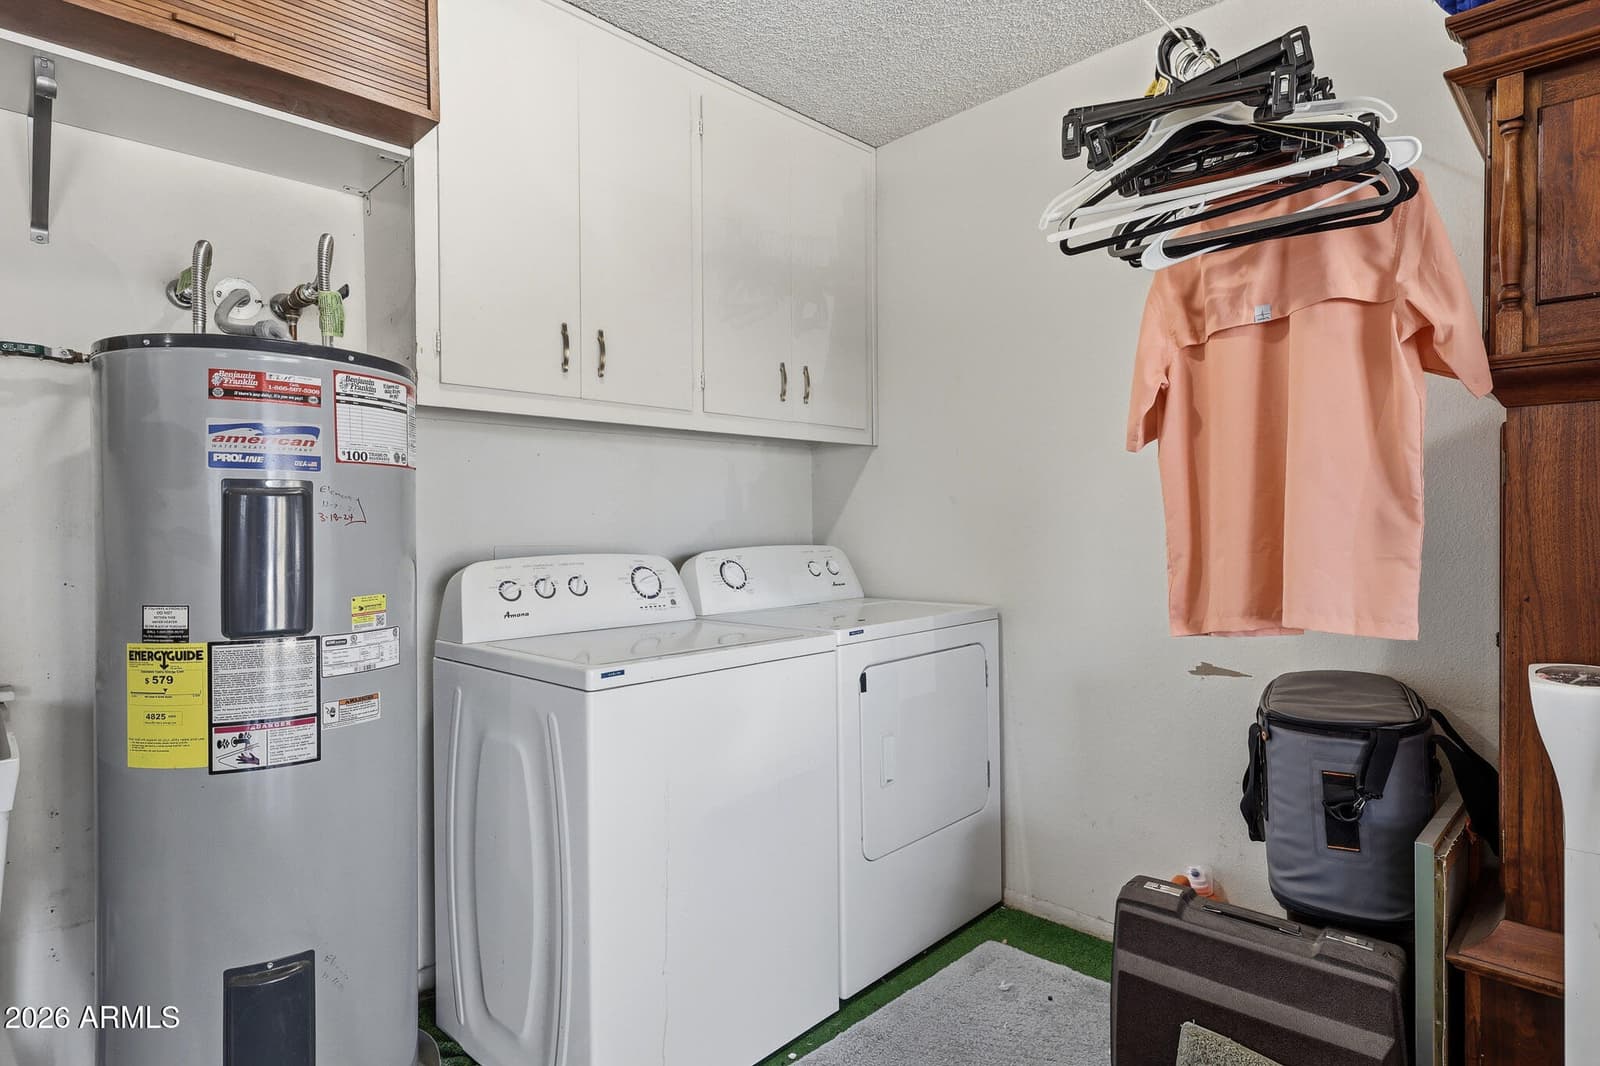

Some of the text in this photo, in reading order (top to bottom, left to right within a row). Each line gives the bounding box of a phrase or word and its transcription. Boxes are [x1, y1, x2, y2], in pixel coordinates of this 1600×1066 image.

[220, 370, 256, 380] Benjamin
[224, 377, 258, 386] Franklin
[345, 375, 375, 386] Benjamin
[350, 382, 377, 393] Franklin
[212, 435, 316, 448] amercan
[213, 453, 265, 463] PROLINE
[503, 611, 529, 619] Amana
[152, 675, 174, 684] 579
[254, 720, 290, 730] DANGER
